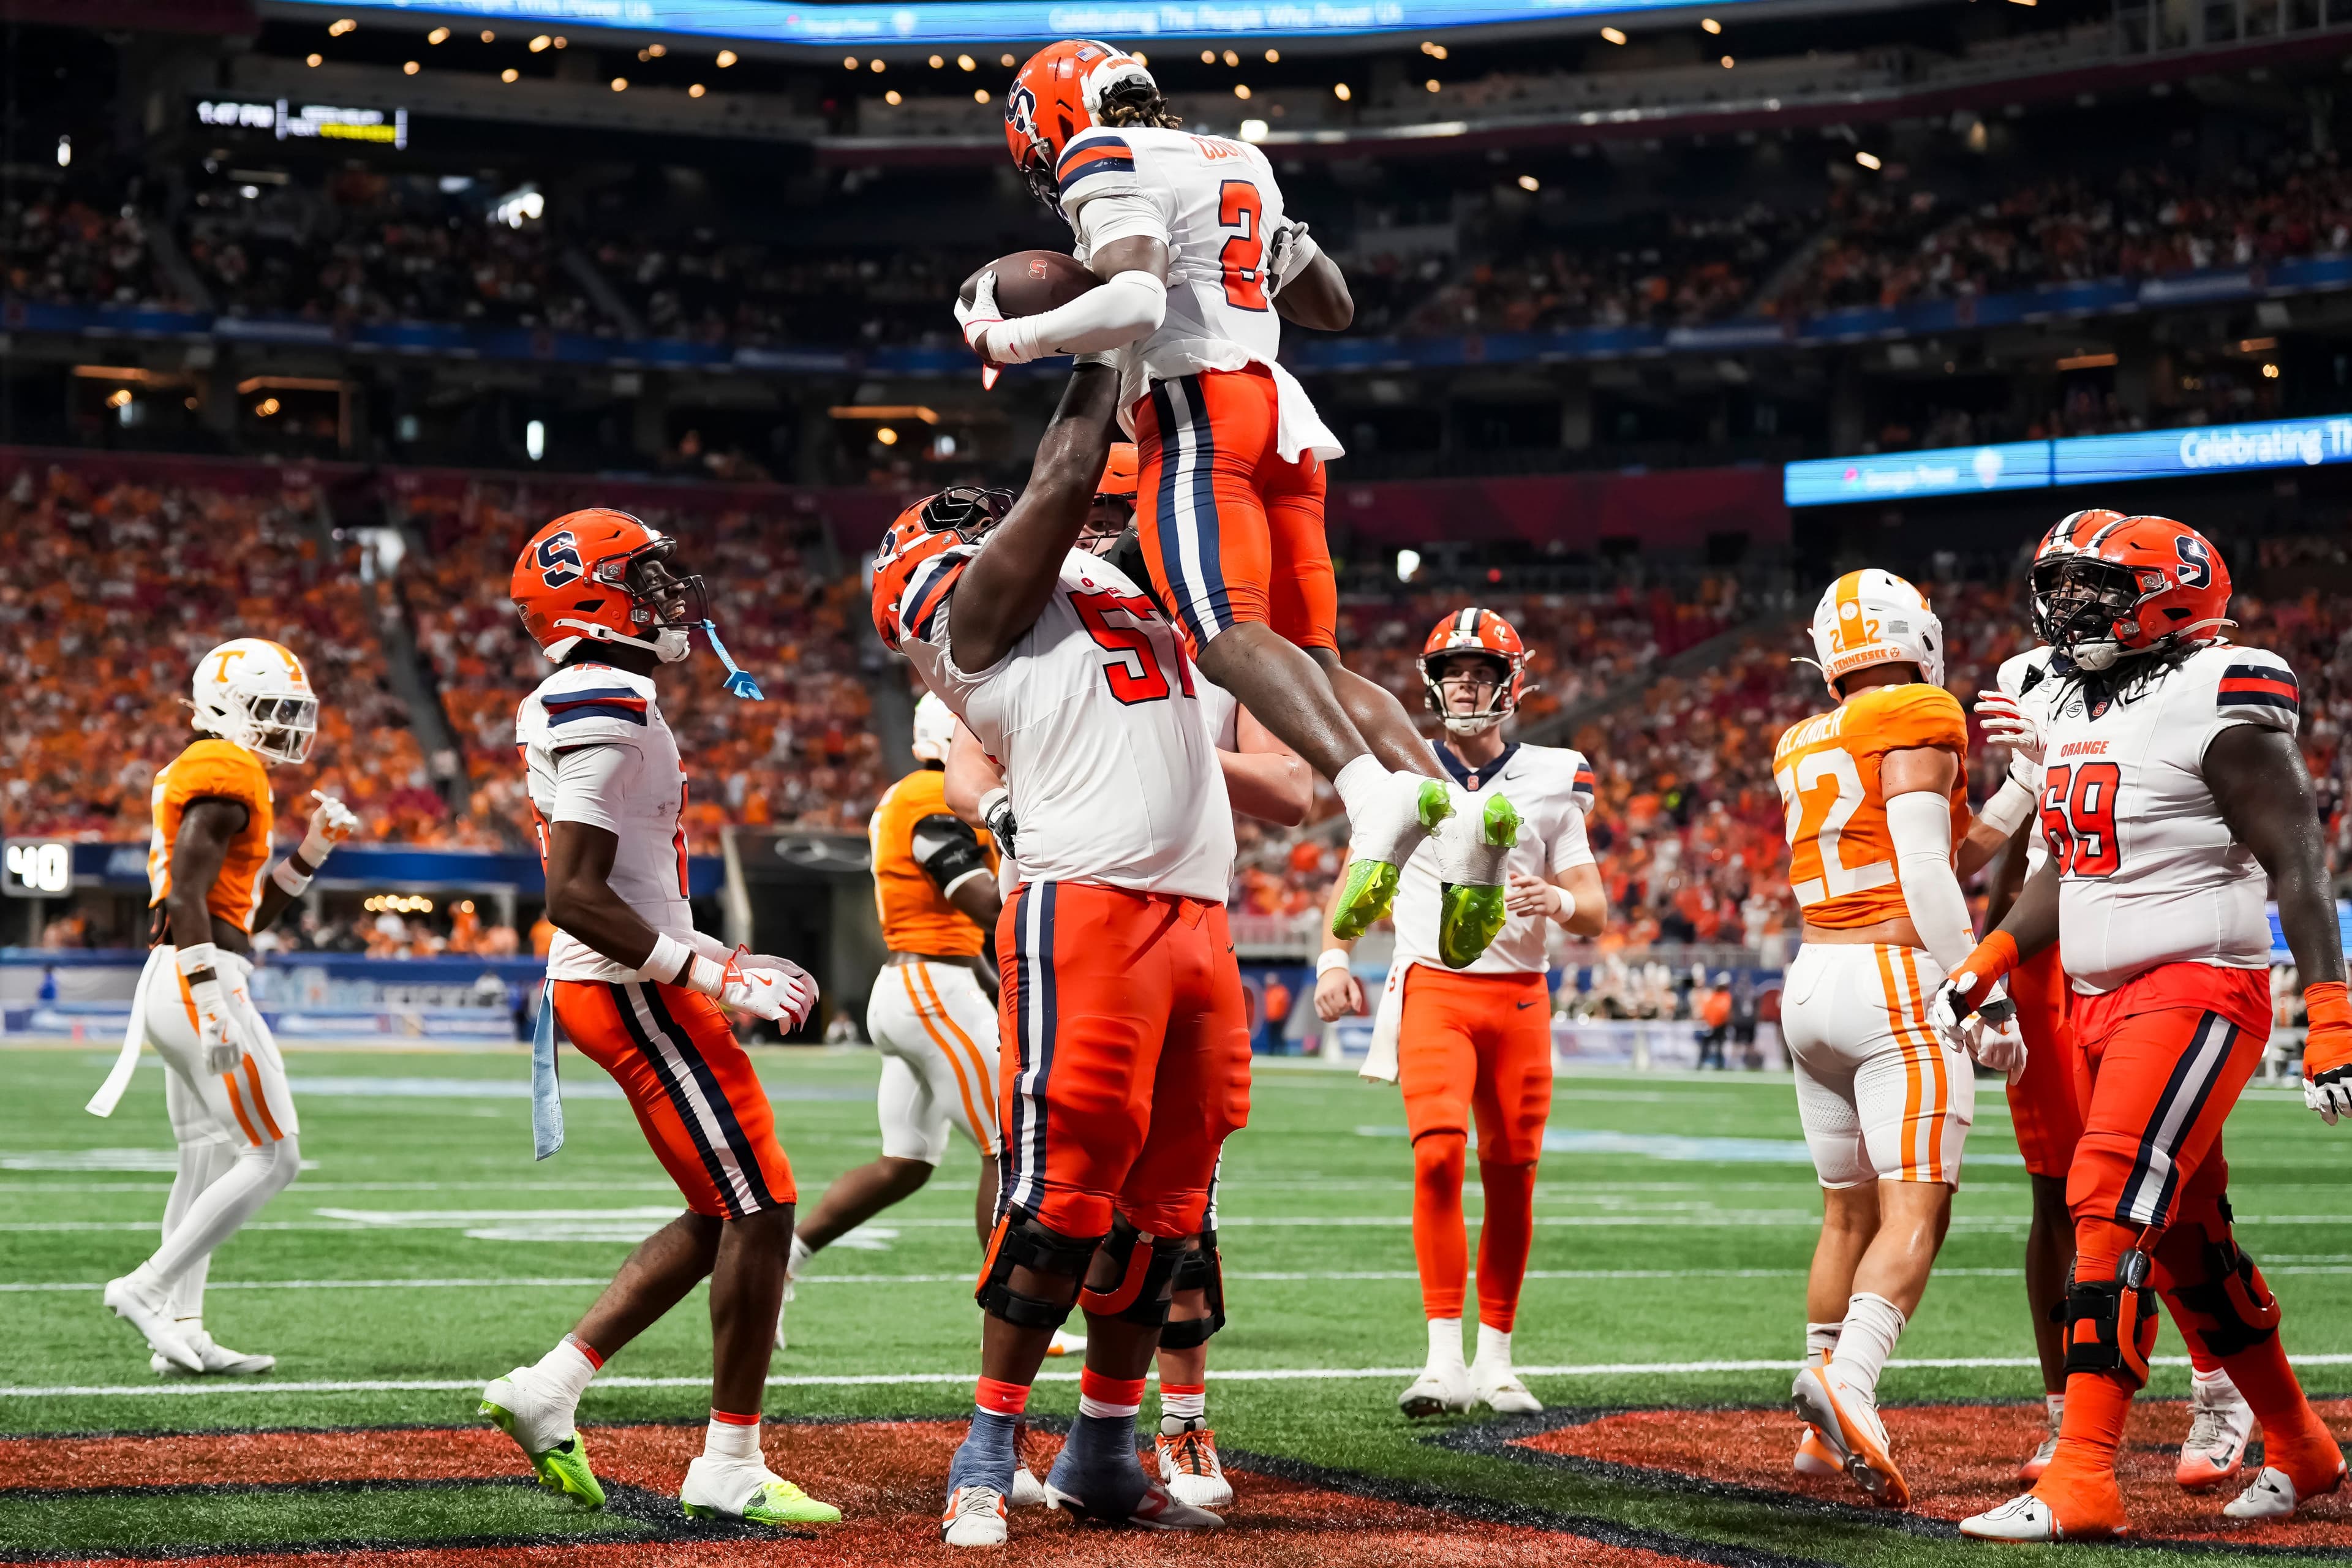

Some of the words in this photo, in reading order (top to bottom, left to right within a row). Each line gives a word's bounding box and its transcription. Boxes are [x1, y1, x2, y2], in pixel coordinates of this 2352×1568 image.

[1218, 179, 1269, 313] 2
[1028, 259, 1047, 279] S
[2180, 429, 2324, 466] Celebrating
[537, 530, 583, 589] S
[1066, 590, 1197, 706] 57
[1830, 629, 1844, 655] 2
[1866, 619, 1882, 644] 2
[215, 650, 247, 683] T
[1833, 649, 1888, 673] TENNESSEE
[2060, 741, 2110, 758] ORANGE
[1776, 746, 1897, 908] 22
[2038, 762, 2122, 878] 69
[7, 843, 69, 892] 40
